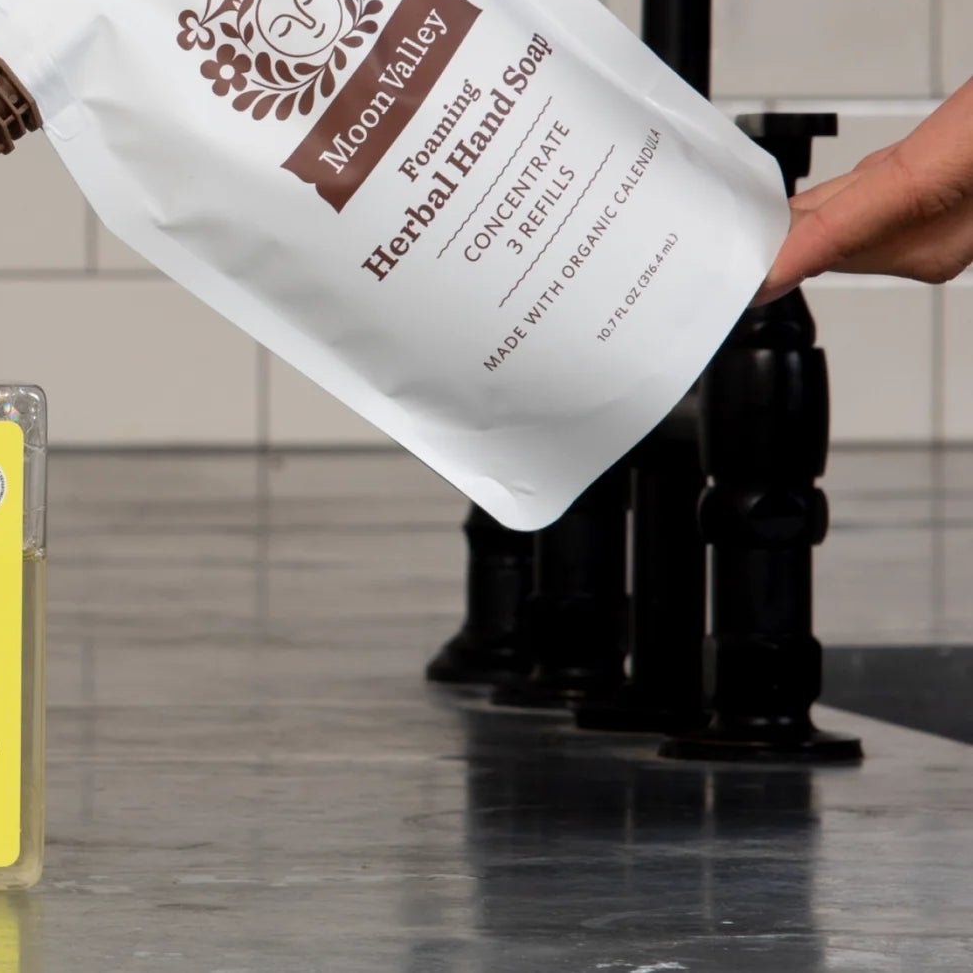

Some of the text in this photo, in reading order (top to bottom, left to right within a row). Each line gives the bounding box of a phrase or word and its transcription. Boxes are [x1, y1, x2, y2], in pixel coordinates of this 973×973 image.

[318, 8, 448, 175] Moon Valley
[361, 32, 553, 282] Herbal Hand Soap
[398, 79, 481, 183] Foaming
[464, 120, 570, 262] CONCENTRATE
[483, 128, 662, 372] MADE WITH ORGANIC CALENDULA
[506, 165, 575, 255] 3 REFILLS
[597, 232, 679, 342] 10.7 FL OZ (316.4 mL)
